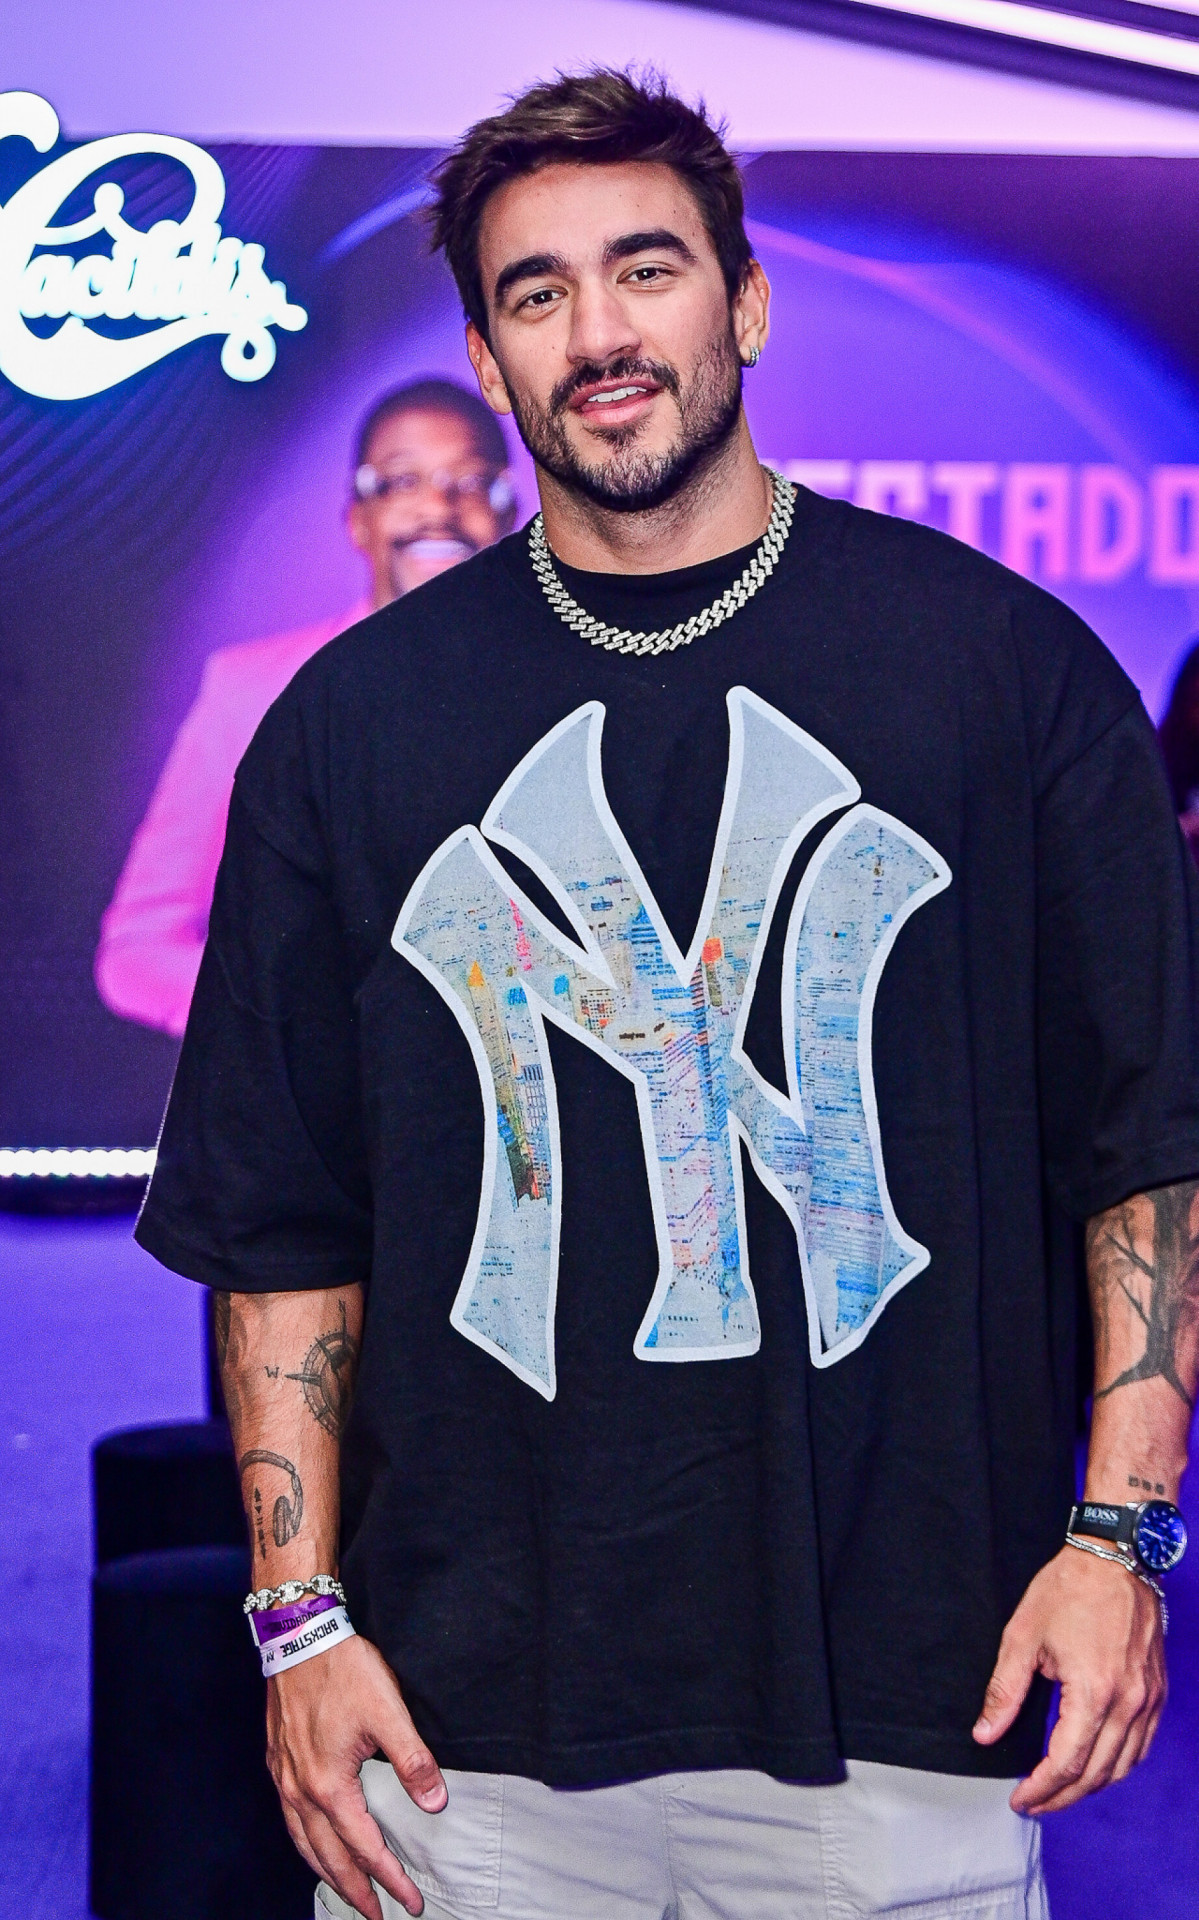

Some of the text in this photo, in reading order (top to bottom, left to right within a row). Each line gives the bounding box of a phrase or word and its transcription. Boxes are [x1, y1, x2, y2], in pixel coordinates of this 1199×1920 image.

[392, 685, 953, 1402] NY
[264, 1365, 280, 1379] W
[1084, 1506, 1119, 1521] BOSS
[280, 1618, 339, 1658] BACKSTAGE
